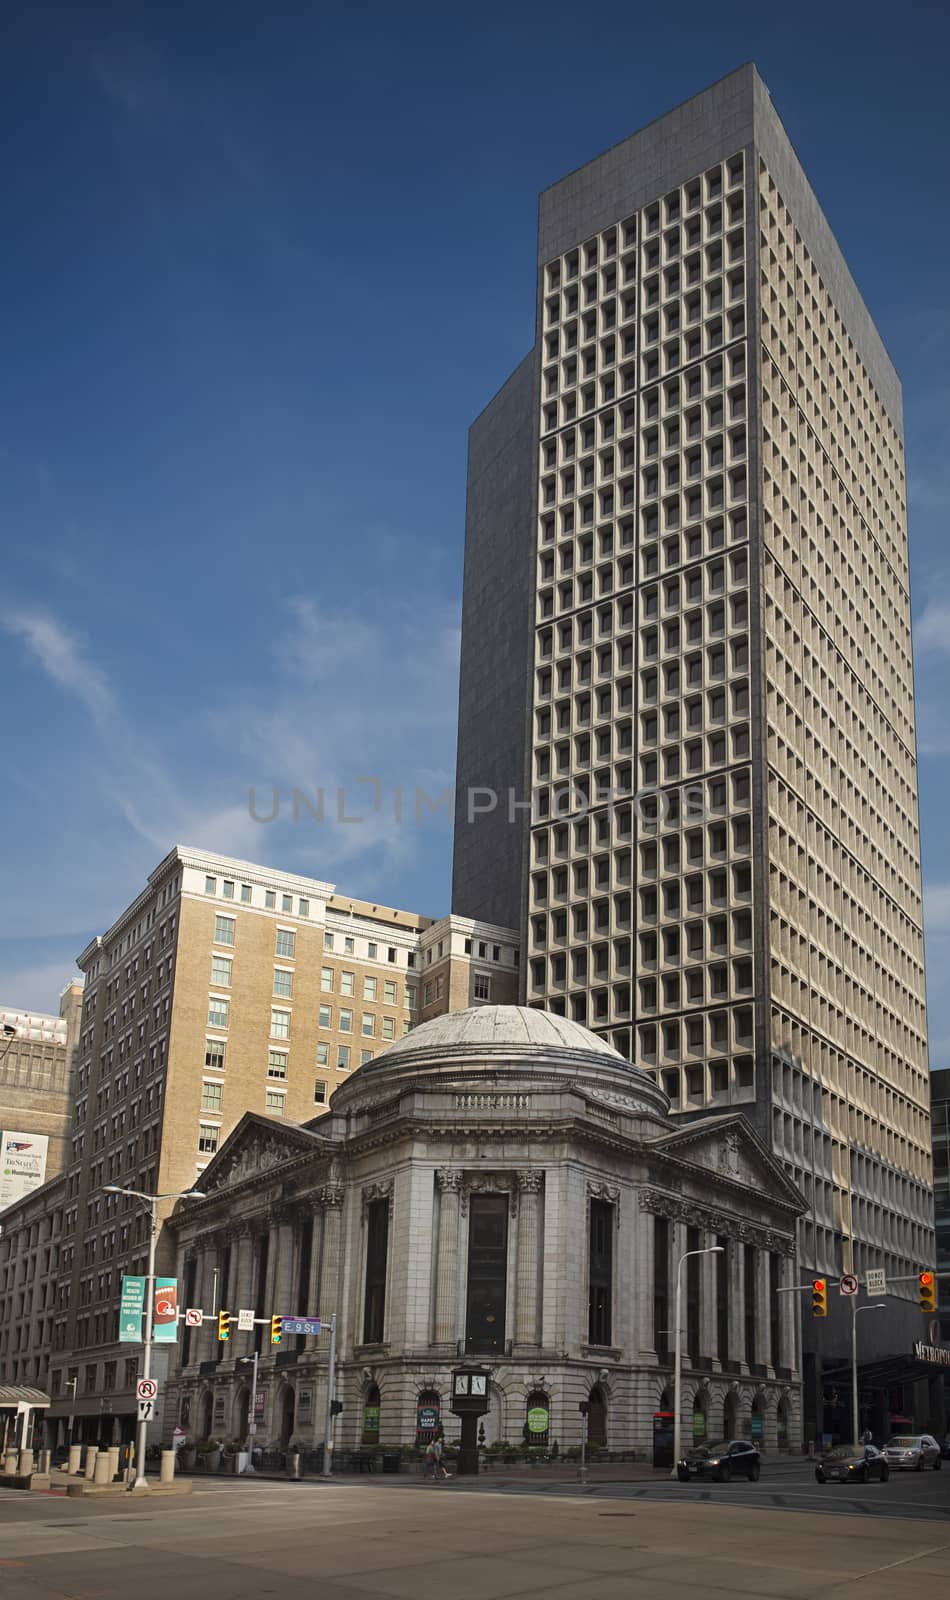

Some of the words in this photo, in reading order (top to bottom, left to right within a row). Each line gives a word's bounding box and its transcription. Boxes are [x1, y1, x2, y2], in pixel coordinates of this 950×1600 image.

[285, 1322, 293, 1331] E
[295, 1323, 302, 1332] 9
[304, 1323, 314, 1333] St
